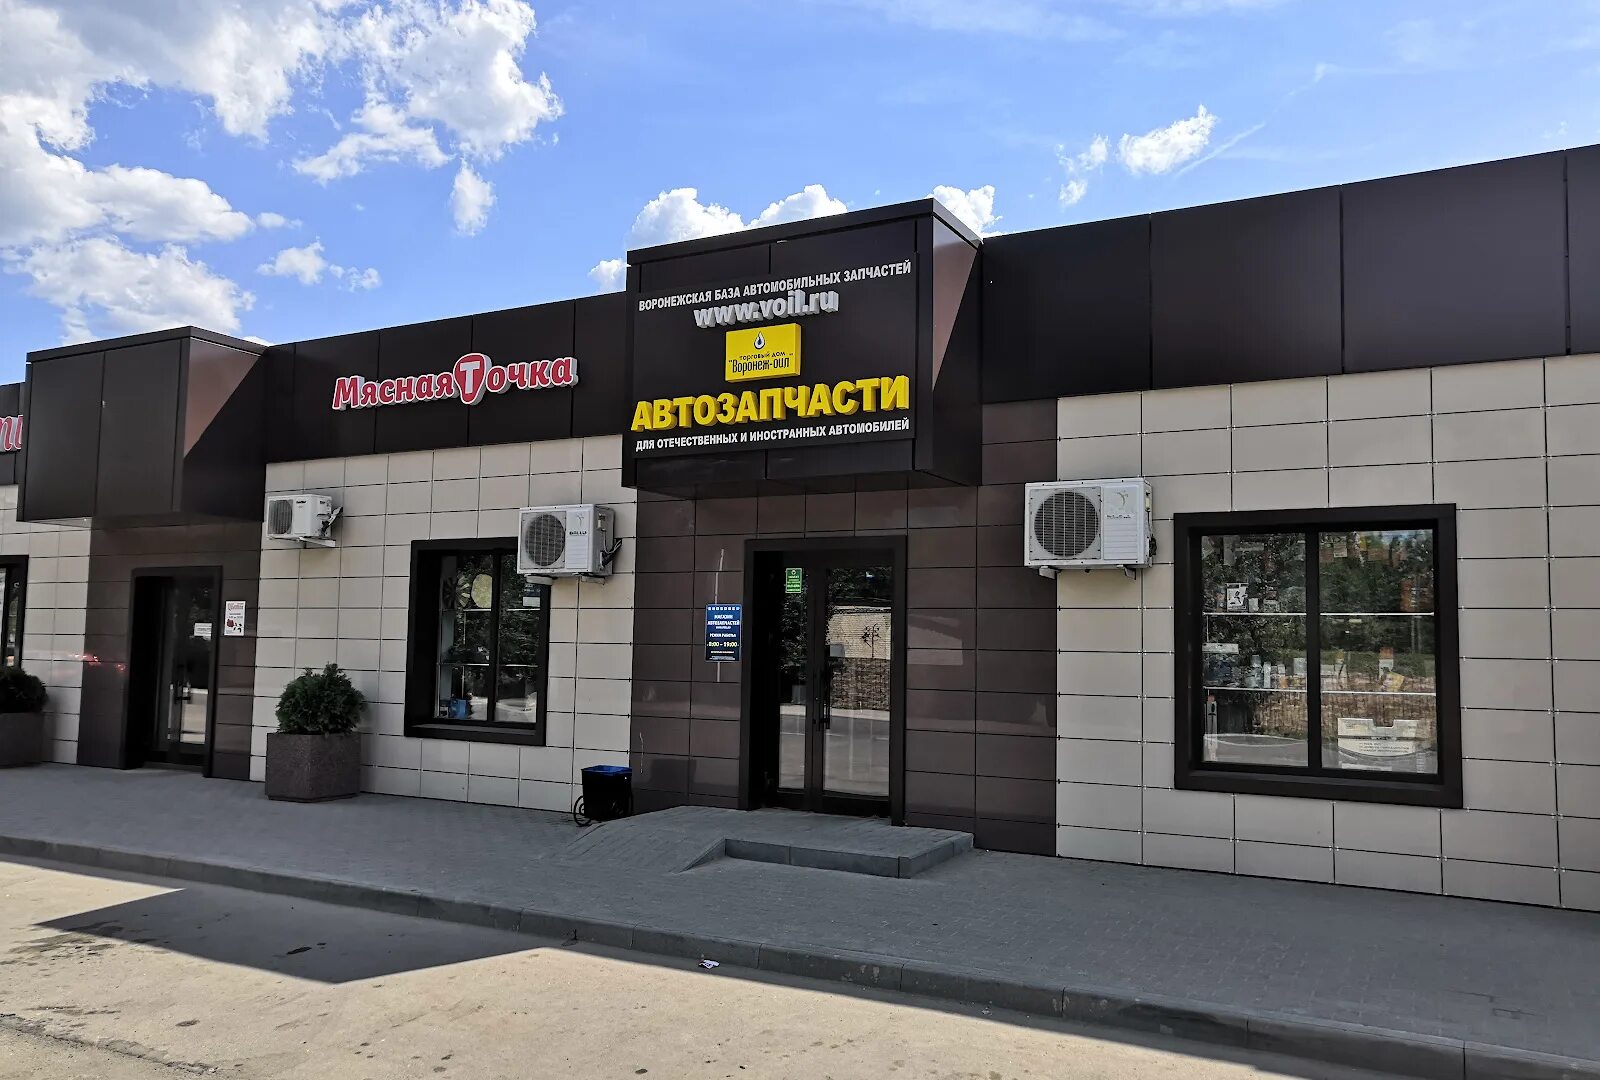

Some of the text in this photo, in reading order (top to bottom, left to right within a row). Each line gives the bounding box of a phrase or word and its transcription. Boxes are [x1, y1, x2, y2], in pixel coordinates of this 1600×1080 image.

[639, 259, 912, 311] ВОРОНЕЖСКАЯ БАЗА АВТОМОБИЛЬНЫХ ЗАПЧАСТЕЙ
[693, 289, 839, 328] www.voil.ru
[332, 353, 578, 410] Мясная Точка
[631, 375, 909, 432] АВТОЗАПЧАСТИ
[635, 417, 910, 452] ДЛЯ ОТЕЧЕСТВЕННЫХ И ИНОСТРАННЫХ АВТОМОБИЛЕЙ
